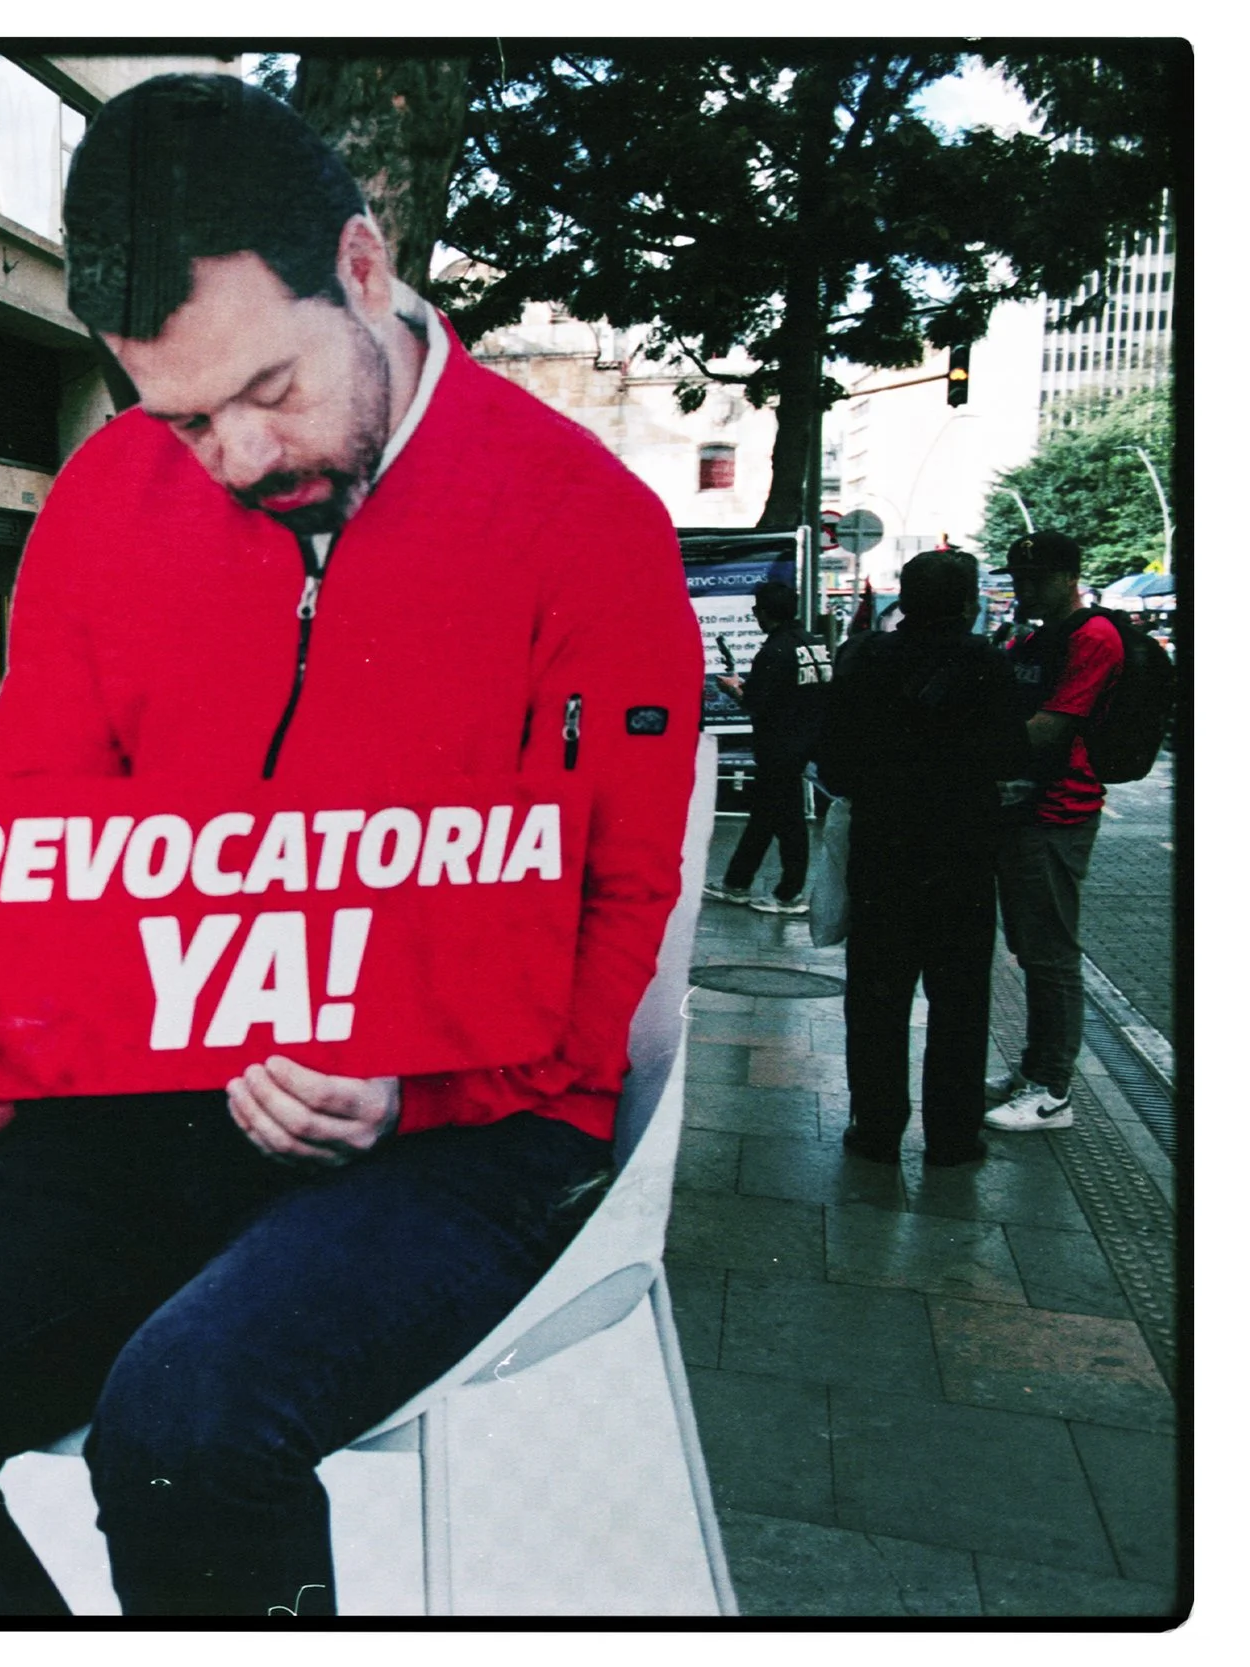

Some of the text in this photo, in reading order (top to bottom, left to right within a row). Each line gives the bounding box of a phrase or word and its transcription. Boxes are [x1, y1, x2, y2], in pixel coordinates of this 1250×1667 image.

[686, 572, 769, 587] RTVC NOTICIAS
[698, 615, 717, 624] $10
[719, 614, 735, 623] mil
[138, 907, 373, 1052] YA!
